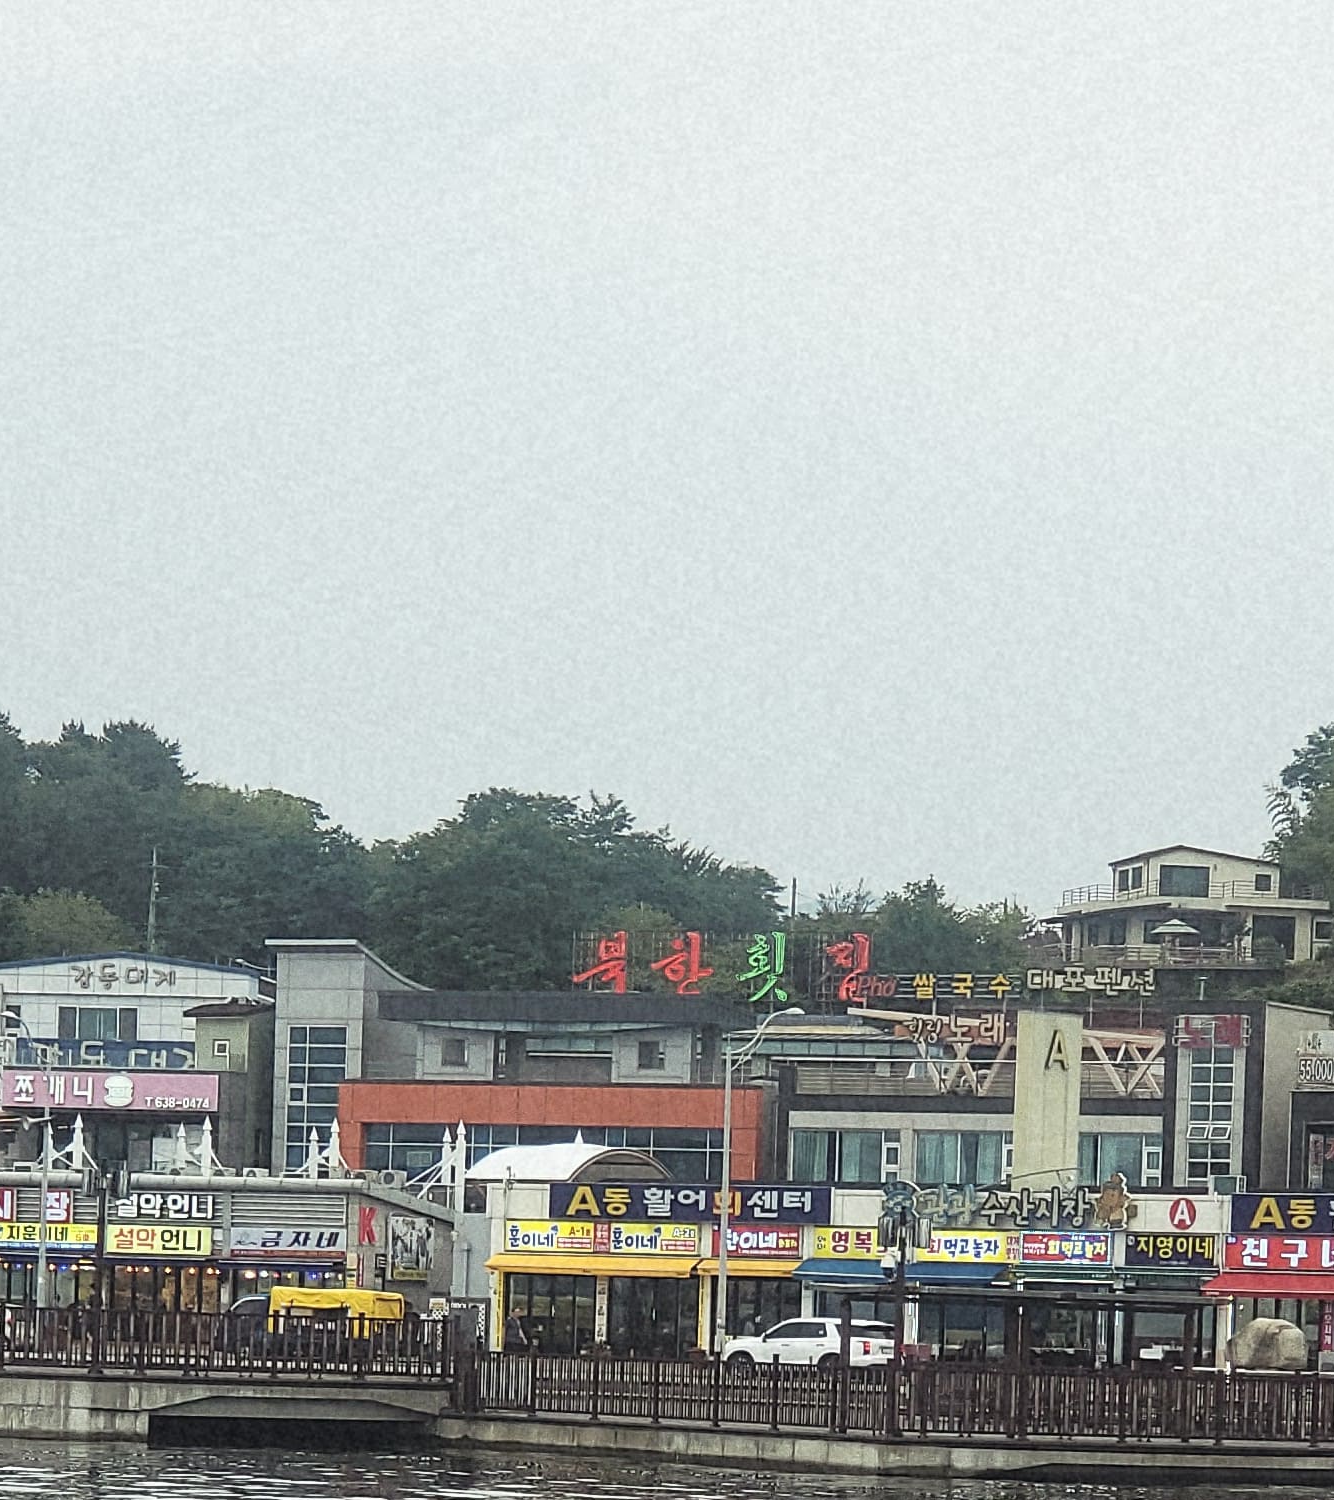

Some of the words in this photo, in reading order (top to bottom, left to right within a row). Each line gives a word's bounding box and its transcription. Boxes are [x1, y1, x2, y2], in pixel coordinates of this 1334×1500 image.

[71, 963, 176, 990] 강동대게
[913, 973, 1012, 999] 쌀국수
[946, 1013, 1005, 1046] 노래
[1045, 1029, 1069, 1072] A
[115, 1193, 213, 1220] 설악언니
[566, 1186, 631, 1216] A동
[981, 1186, 1092, 1228] 수산시장
[1173, 1199, 1192, 1226] A
[1250, 1197, 1317, 1229] A동
[261, 1230, 340, 1249] 금자네
[509, 1225, 554, 1248] 훈이네
[612, 1227, 657, 1250] 훈이네
[831, 1230, 888, 1254] 영복
[1137, 1236, 1214, 1259] 지영이네
